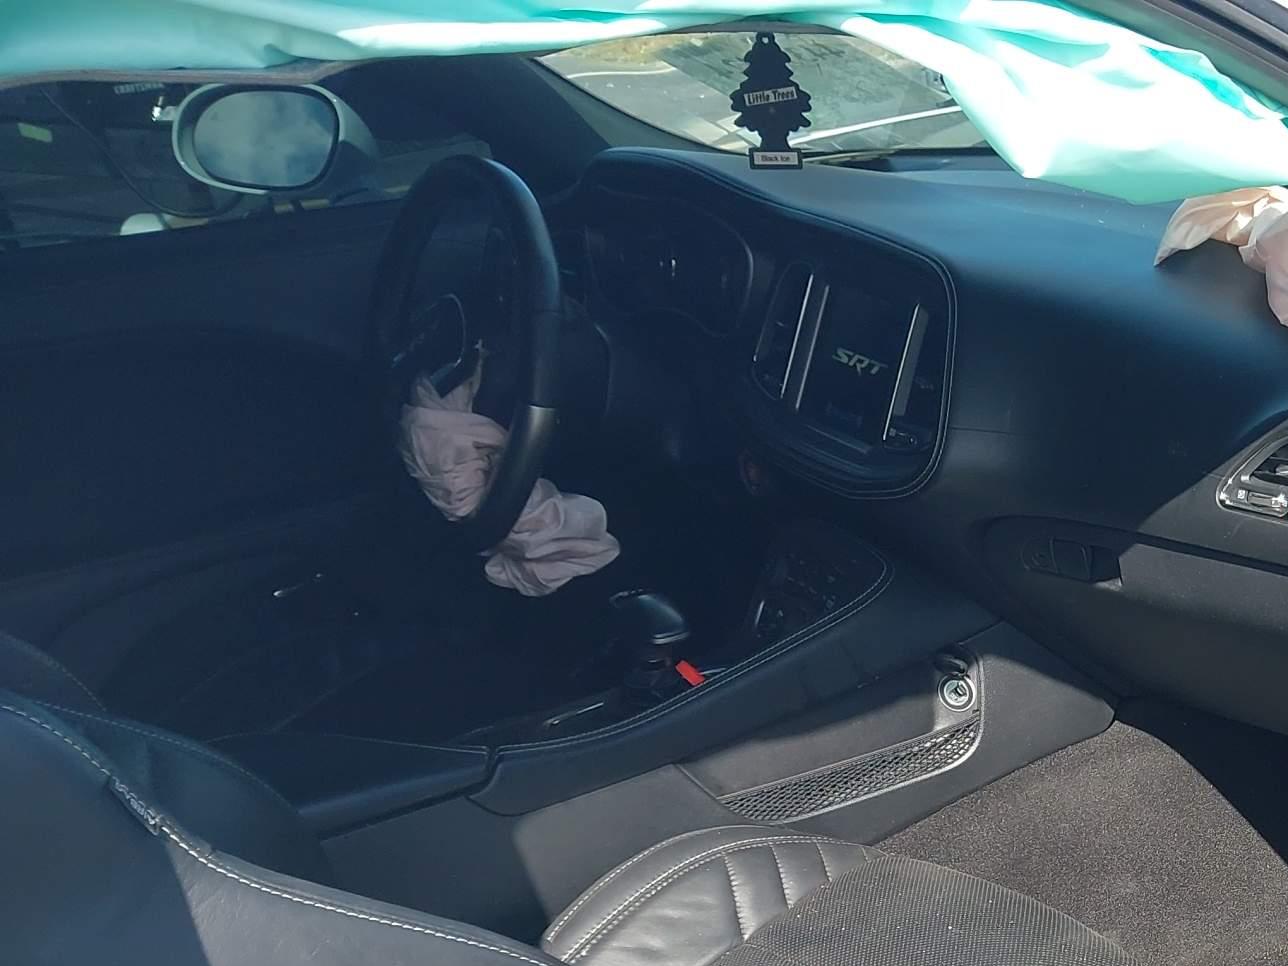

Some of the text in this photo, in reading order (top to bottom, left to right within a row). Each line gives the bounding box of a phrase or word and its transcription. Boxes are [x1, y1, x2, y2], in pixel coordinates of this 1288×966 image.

[747, 88, 795, 105] Little Trees
[831, 347, 889, 376] SRT
